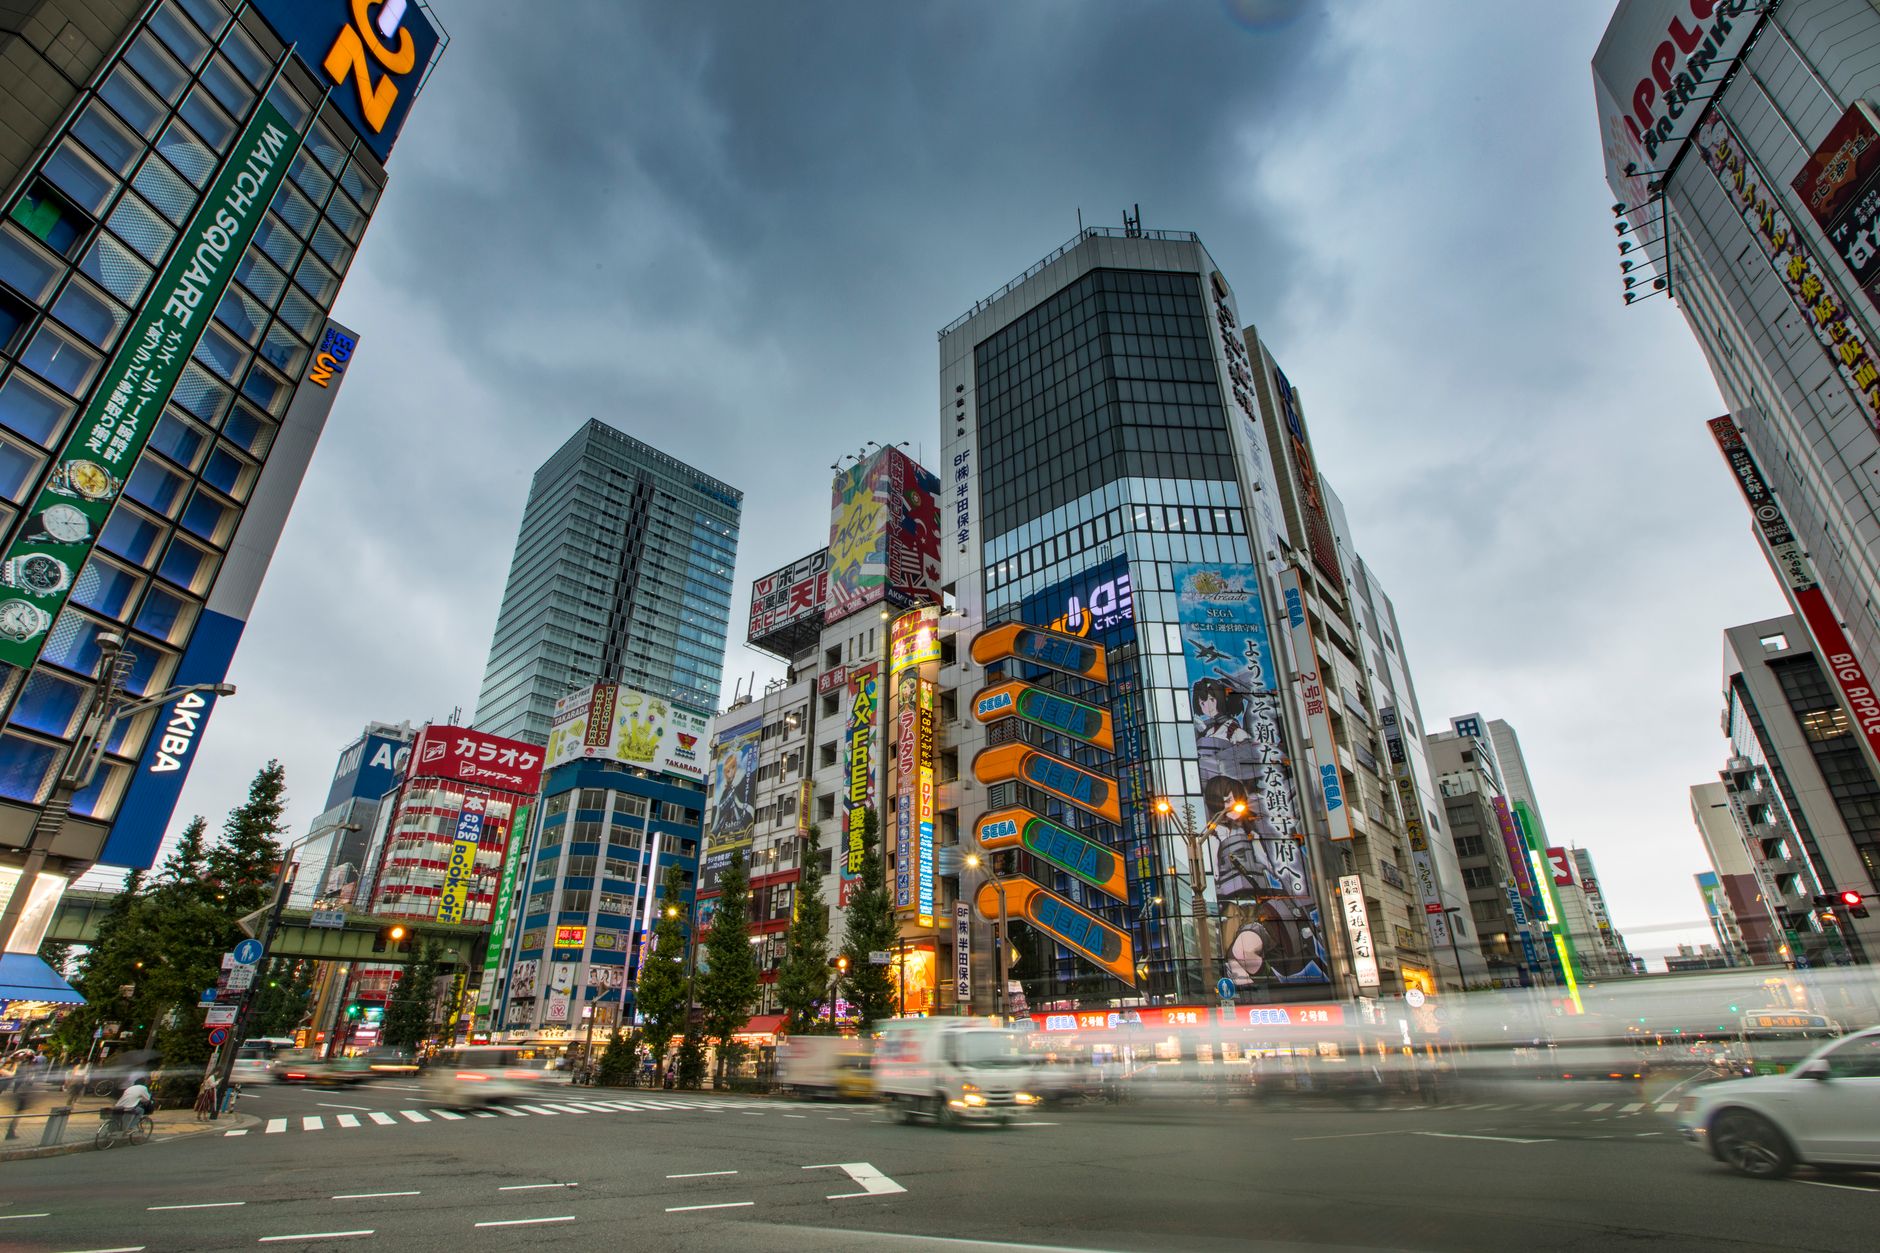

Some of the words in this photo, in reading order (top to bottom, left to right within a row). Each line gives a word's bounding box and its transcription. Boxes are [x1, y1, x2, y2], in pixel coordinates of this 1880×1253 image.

[227, 122, 288, 220] WATCH
[1832, 222, 1849, 243] 7F
[163, 209, 241, 329] SQUARE
[309, 331, 355, 389] EDION
[85, 319, 166, 454] 人気ブランド多数取り揃え
[103, 330, 182, 464] メンズ・レディース腕時計
[954, 449, 971, 467] 8F
[752, 590, 788, 617] 秋葉原
[1206, 608, 1234, 618] SEGA
[1284, 588, 1305, 628] SEGA
[751, 609, 787, 633] ホビー
[820, 671, 845, 690] 免税
[1830, 653, 1861, 681] BIG
[600, 687, 615, 729] WELCOME
[853, 673, 872, 727] TAX
[978, 692, 1012, 715] SEGA
[1301, 671, 1324, 717] 2号館
[554, 705, 589, 726] TAKARADA
[588, 689, 605, 745] AKIHABARA
[673, 711, 687, 721] TAX
[691, 717, 706, 727] FREE
[922, 717, 931, 726] CD
[1029, 693, 1087, 734] SEGA
[150, 692, 206, 773] AKIBA
[598, 732, 607, 746] TO
[900, 712, 915, 775] ラムタラ
[335, 743, 364, 781] AOKI
[454, 737, 539, 770] カラオケ
[665, 758, 702, 774] TAKARADA
[851, 728, 869, 802] FREE
[1243, 640, 1303, 893] ようこそ新たな鎮守府へ。
[476, 768, 523, 784] アドアーズ
[1030, 757, 1091, 803] SEGA
[1319, 764, 1342, 812] SEGA
[464, 796, 485, 811] 本
[922, 783, 931, 817] DVD
[459, 821, 480, 833] ゲーム
[464, 814, 479, 822] CD
[981, 819, 1018, 841] SEGA
[457, 831, 478, 842] DVD
[1034, 825, 1097, 879] SEGA
[493, 836, 521, 938] 格安スマホ
[957, 907, 969, 917] 8F
[1507, 889, 1527, 925] ALINCO
[1040, 900, 1104, 956] SEGA
[1046, 1015, 1077, 1030] SEGA
[1081, 1015, 1104, 1028] 2号館
[1168, 1012, 1197, 1024] 2号館
[1250, 1009, 1291, 1025] SEGA
[1300, 1010, 1328, 1023] 2号館
